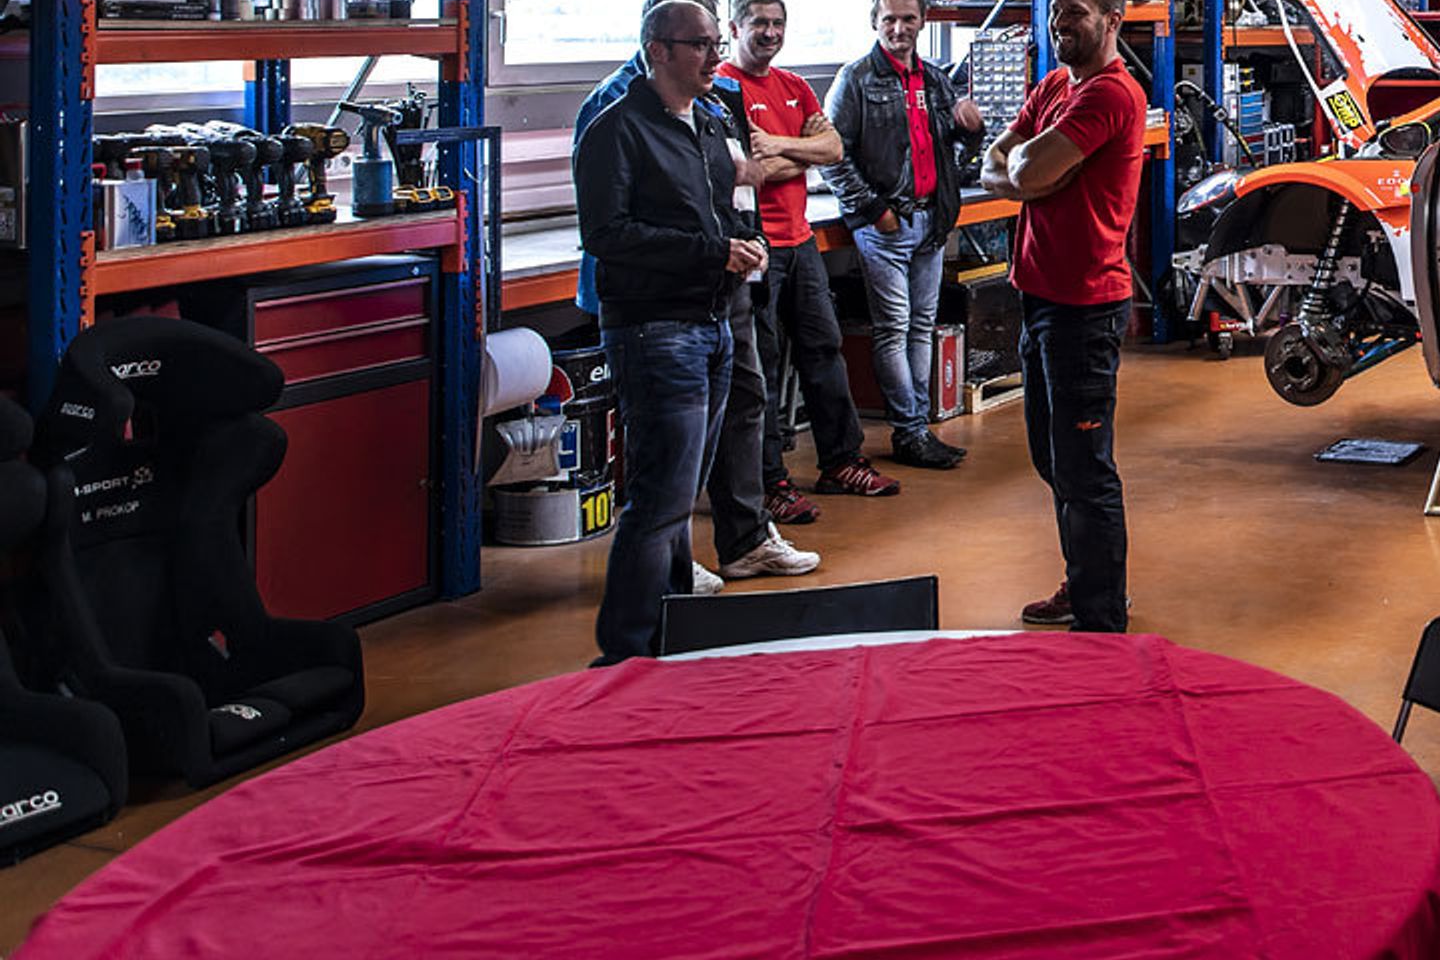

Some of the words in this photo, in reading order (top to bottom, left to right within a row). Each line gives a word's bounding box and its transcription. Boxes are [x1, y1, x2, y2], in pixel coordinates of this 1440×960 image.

[111, 360, 161, 379] arco
[582, 493, 613, 531] 10
[0, 790, 62, 826] arco
